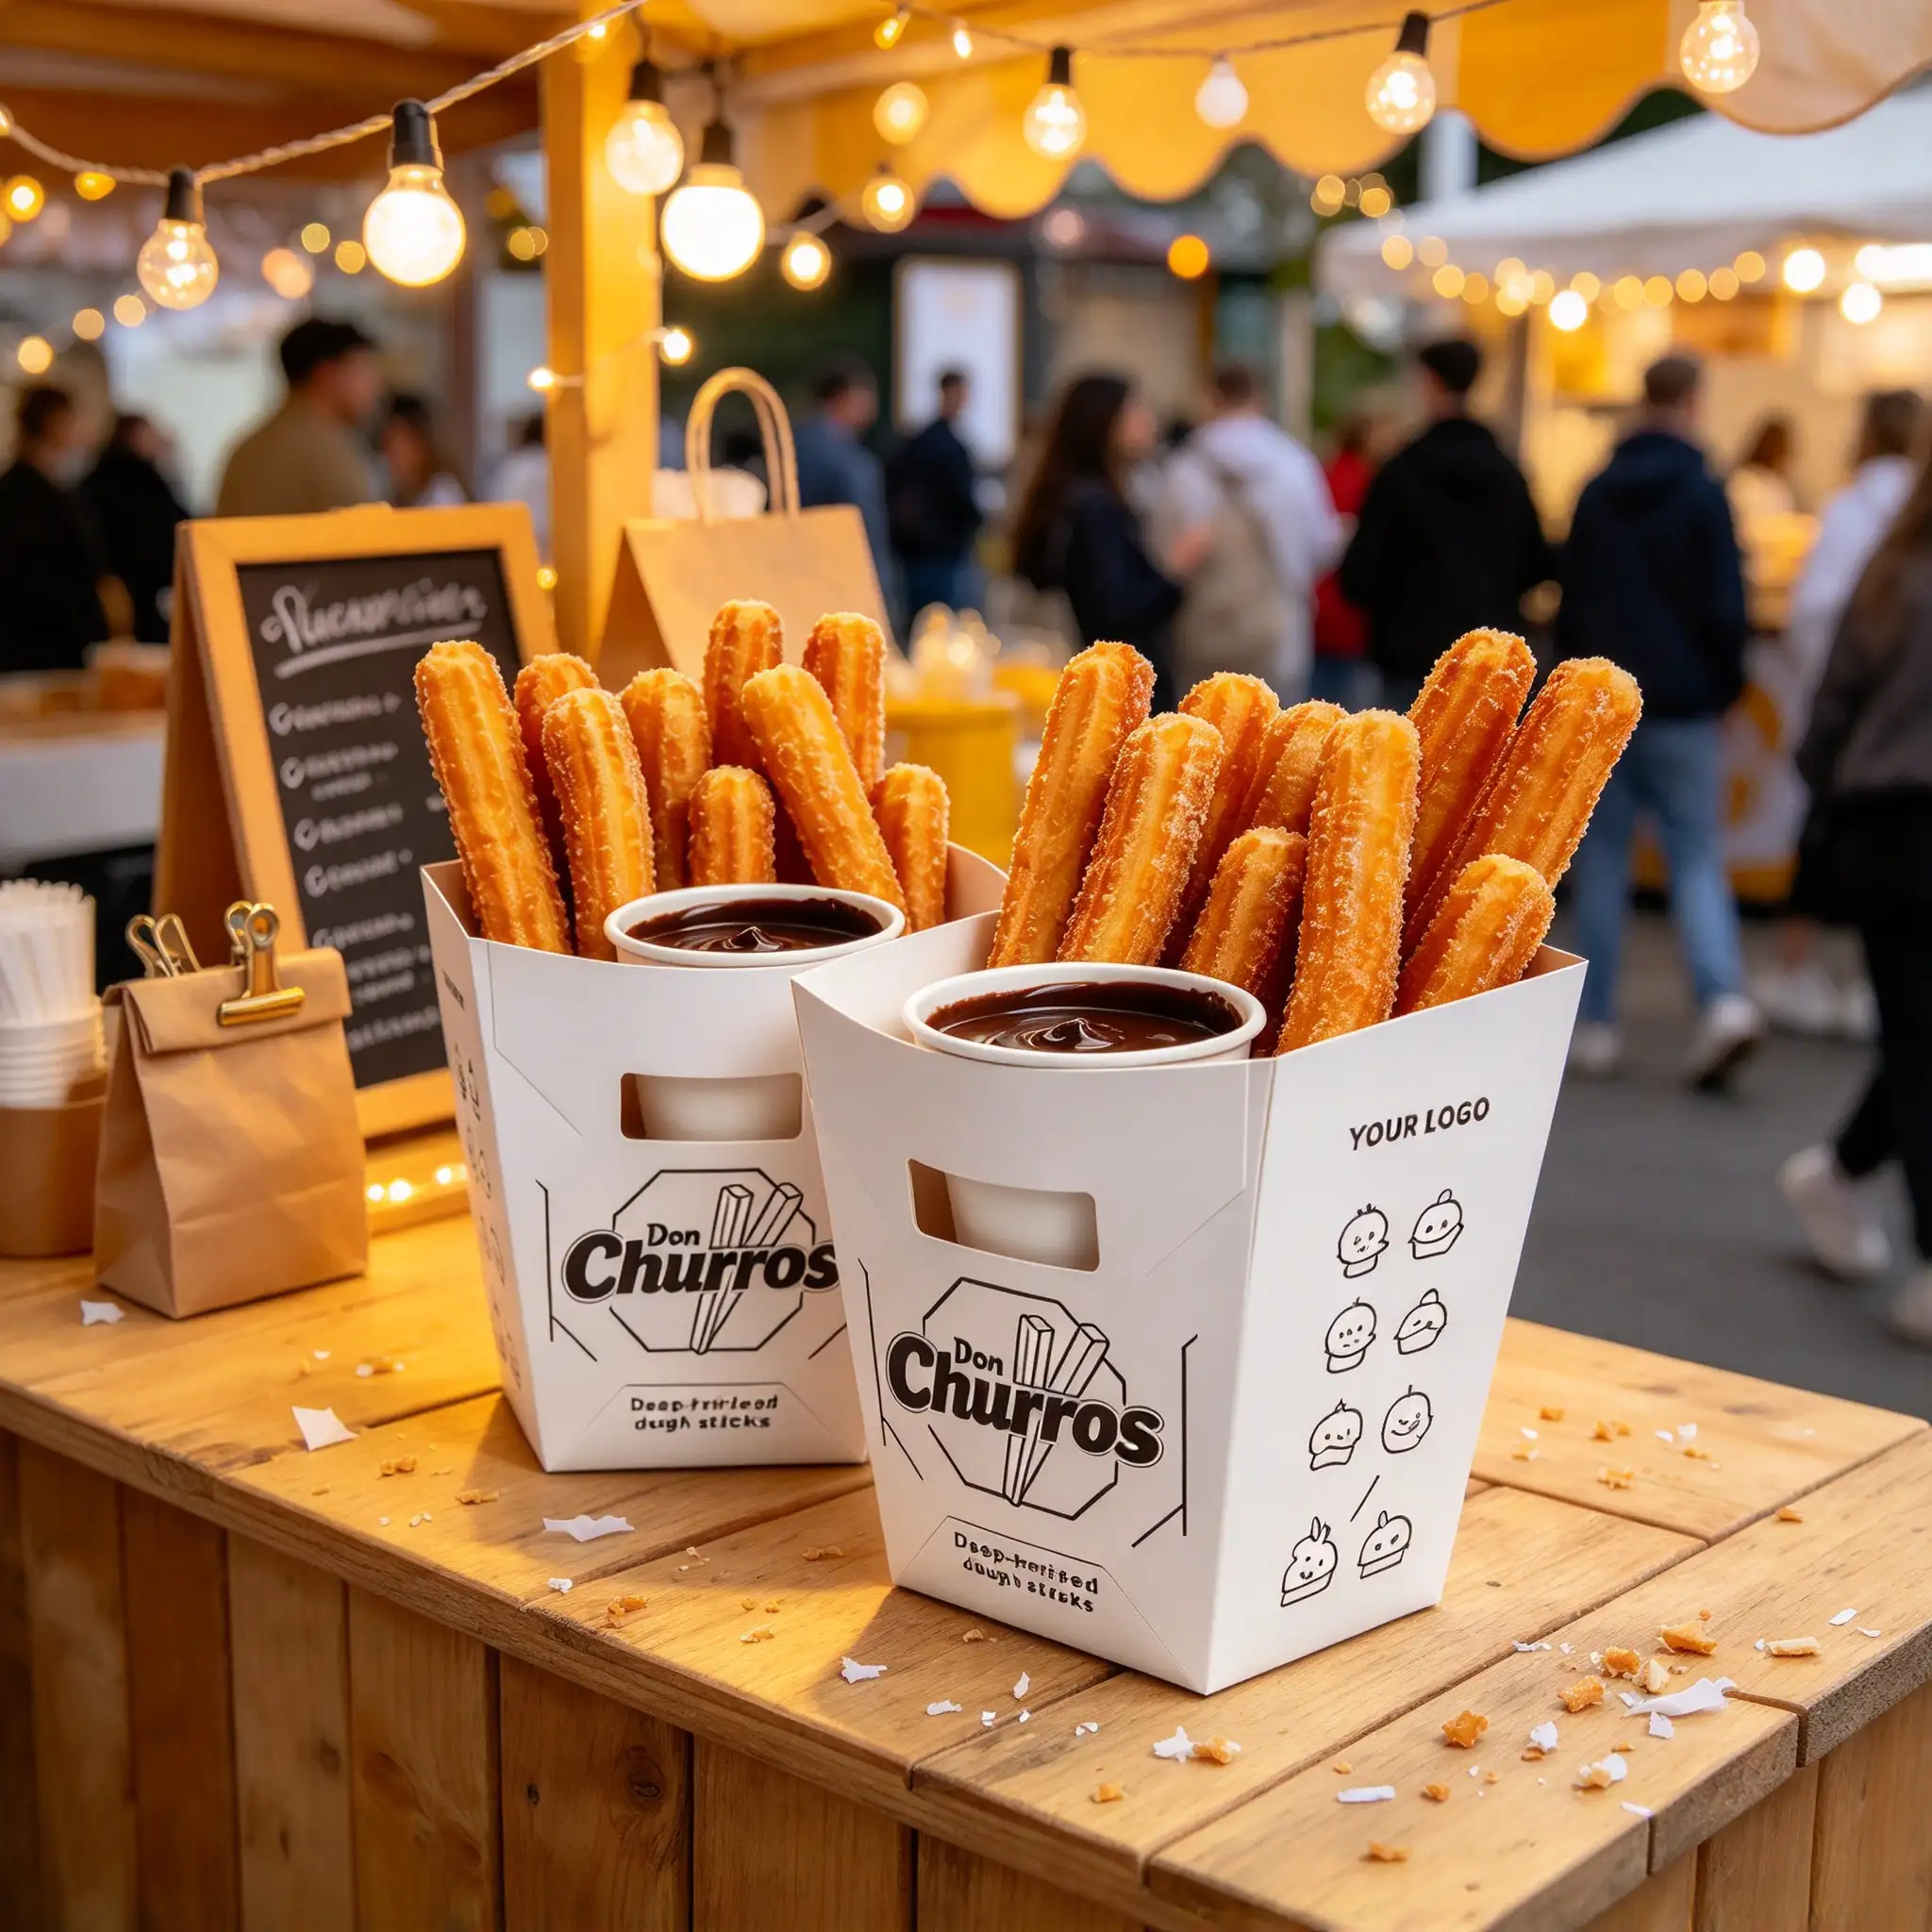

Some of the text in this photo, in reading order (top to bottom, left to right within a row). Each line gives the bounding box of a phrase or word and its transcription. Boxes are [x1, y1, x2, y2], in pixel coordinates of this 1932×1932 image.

[1349, 1096, 1491, 1151] YOUR LOGO
[646, 1223, 701, 1247] Don
[562, 1230, 840, 1303] Churros
[953, 1336, 1004, 1376] Don
[698, 1414, 771, 1430] sticks
[886, 1331, 1164, 1468] Churros
